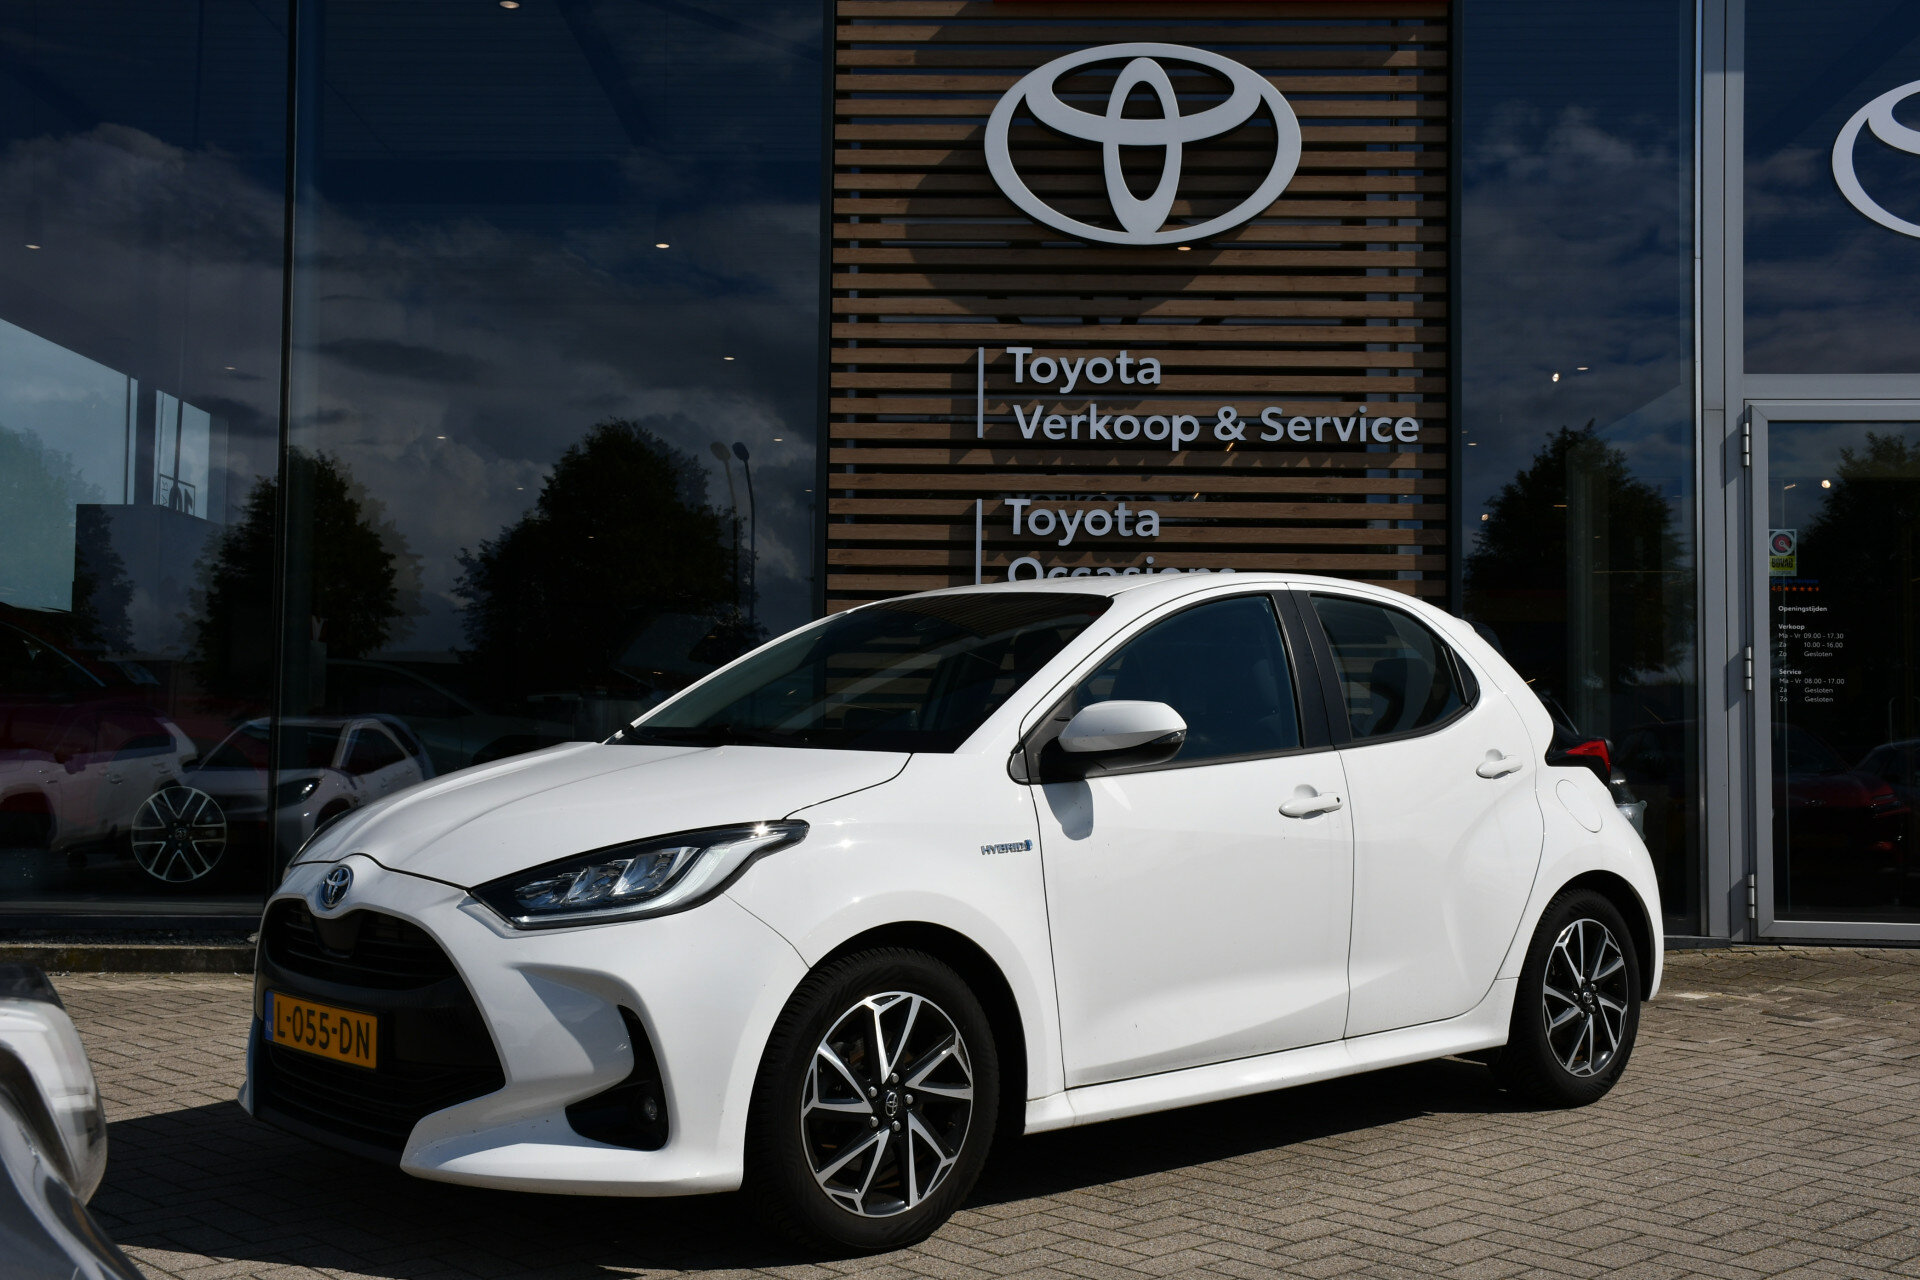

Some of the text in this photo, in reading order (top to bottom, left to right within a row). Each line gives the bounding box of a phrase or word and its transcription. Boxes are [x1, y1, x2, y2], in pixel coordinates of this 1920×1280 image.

[1006, 346, 1161, 393] Toyota
[1013, 403, 1420, 452] Verkoop & Service
[1004, 498, 1160, 546] Toyota
[1778, 605, 1828, 614] Openingstijden
[981, 842, 1027, 855] HYBRID
[265, 1001, 370, 1060] NL L-055-DN
